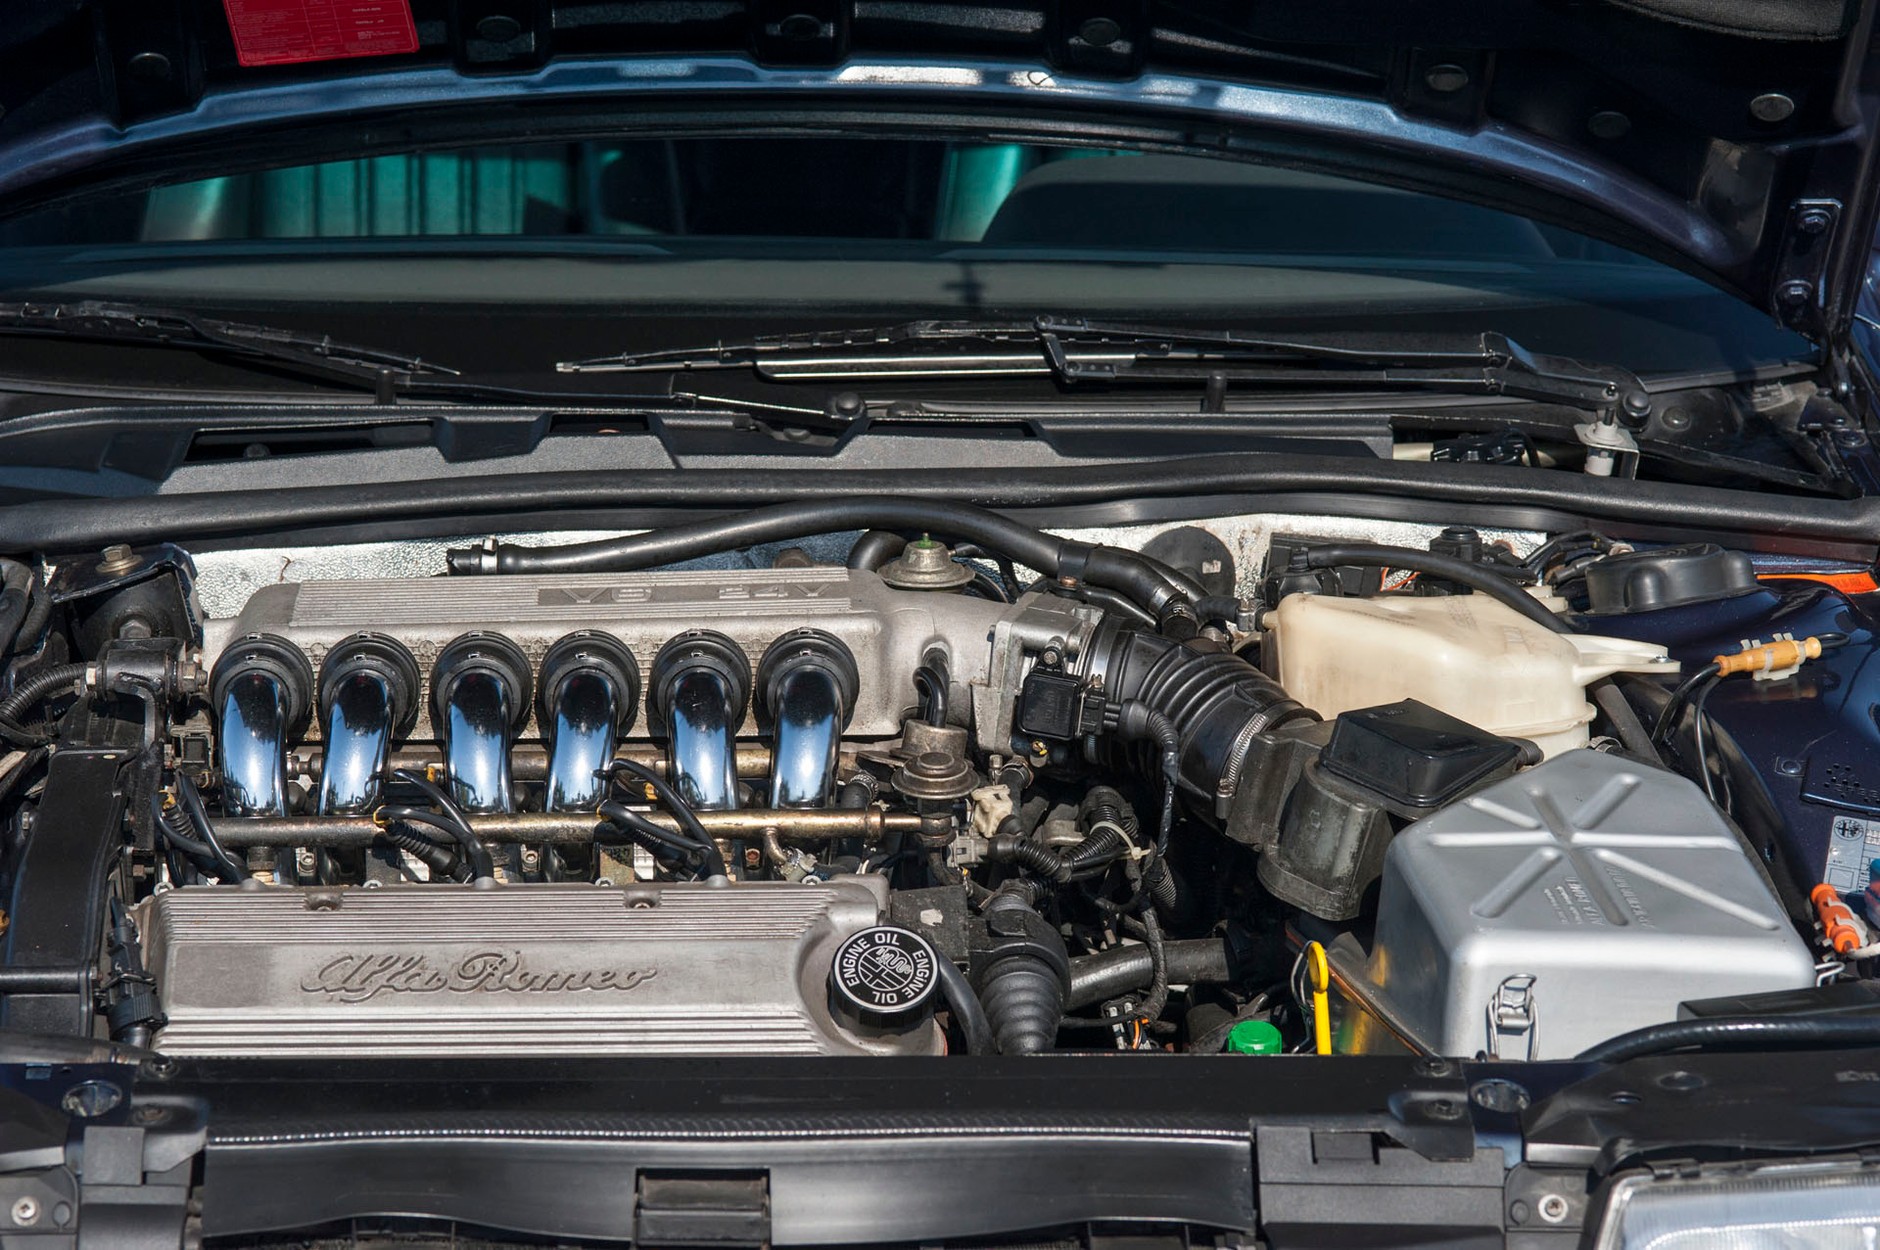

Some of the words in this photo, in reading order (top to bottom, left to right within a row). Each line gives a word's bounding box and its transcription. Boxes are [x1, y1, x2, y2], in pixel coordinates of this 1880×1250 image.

[561, 585, 653, 603] V6
[718, 582, 831, 600] 24V
[299, 952, 448, 1005] Alfa
[447, 949, 659, 995] Romeo
[843, 937, 871, 987] ENGINE
[874, 932, 900, 946] OIL
[901, 949, 930, 999] ENGINE
[872, 991, 898, 1004] OIL
